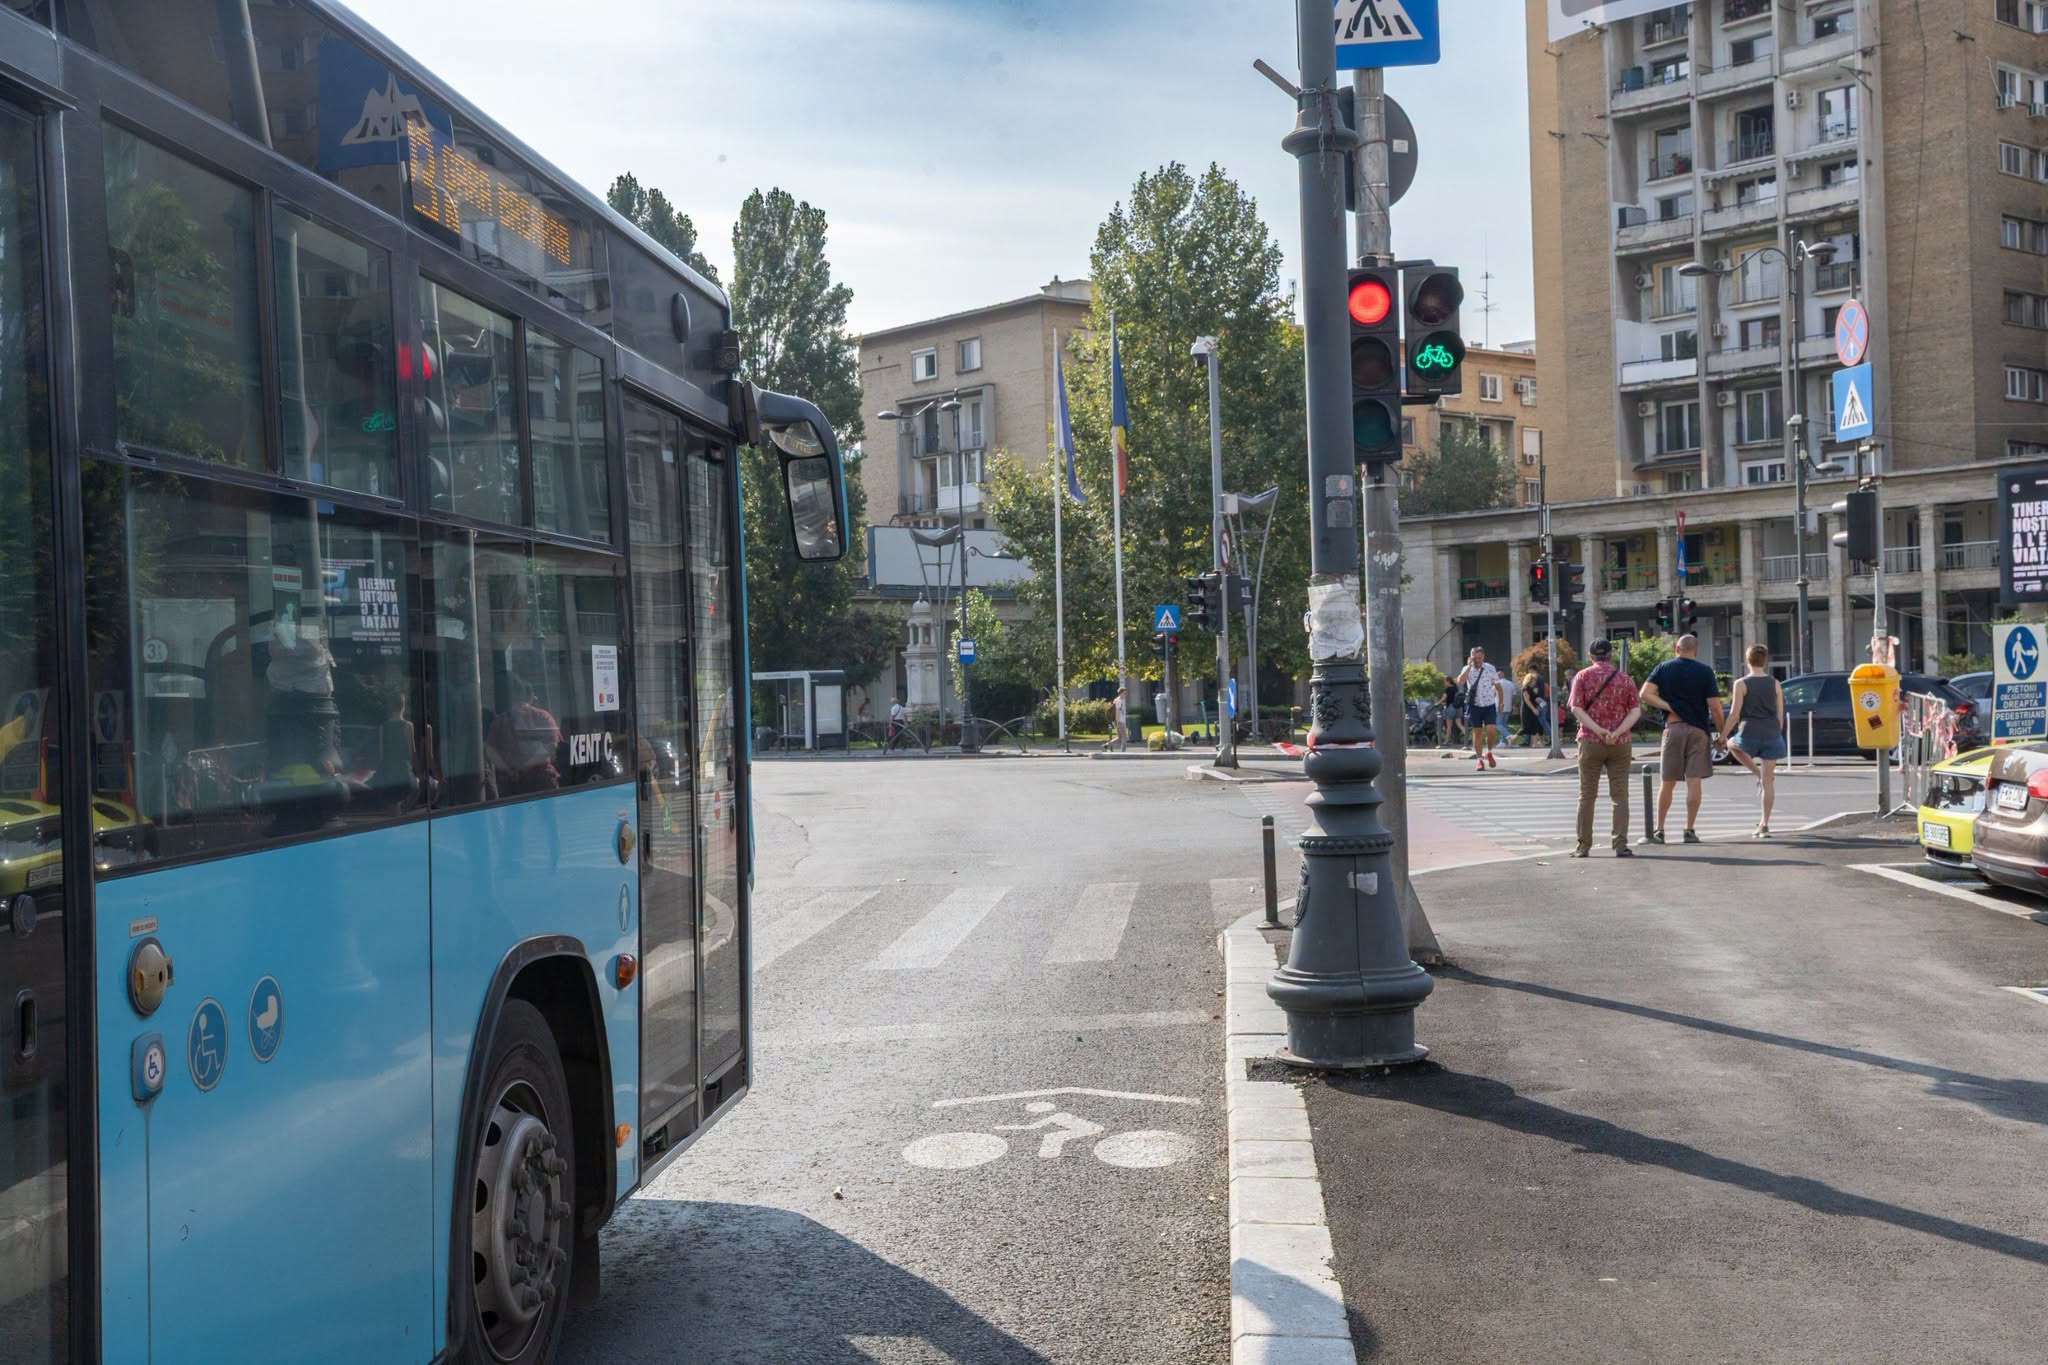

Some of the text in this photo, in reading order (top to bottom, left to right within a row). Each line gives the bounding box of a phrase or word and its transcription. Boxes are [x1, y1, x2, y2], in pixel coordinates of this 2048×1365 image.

[2007, 685, 2037, 693] PIETONI
[2000, 693, 2034, 701] OBLIGATORIU
[2003, 699, 2038, 709] DREAPTA
[1996, 711, 2046, 720] PEDESTRIANS
[2006, 719, 2035, 728] MUST KEEP
[2009, 727, 2032, 735] RIGHT
[570, 732, 613, 765] KENT C
